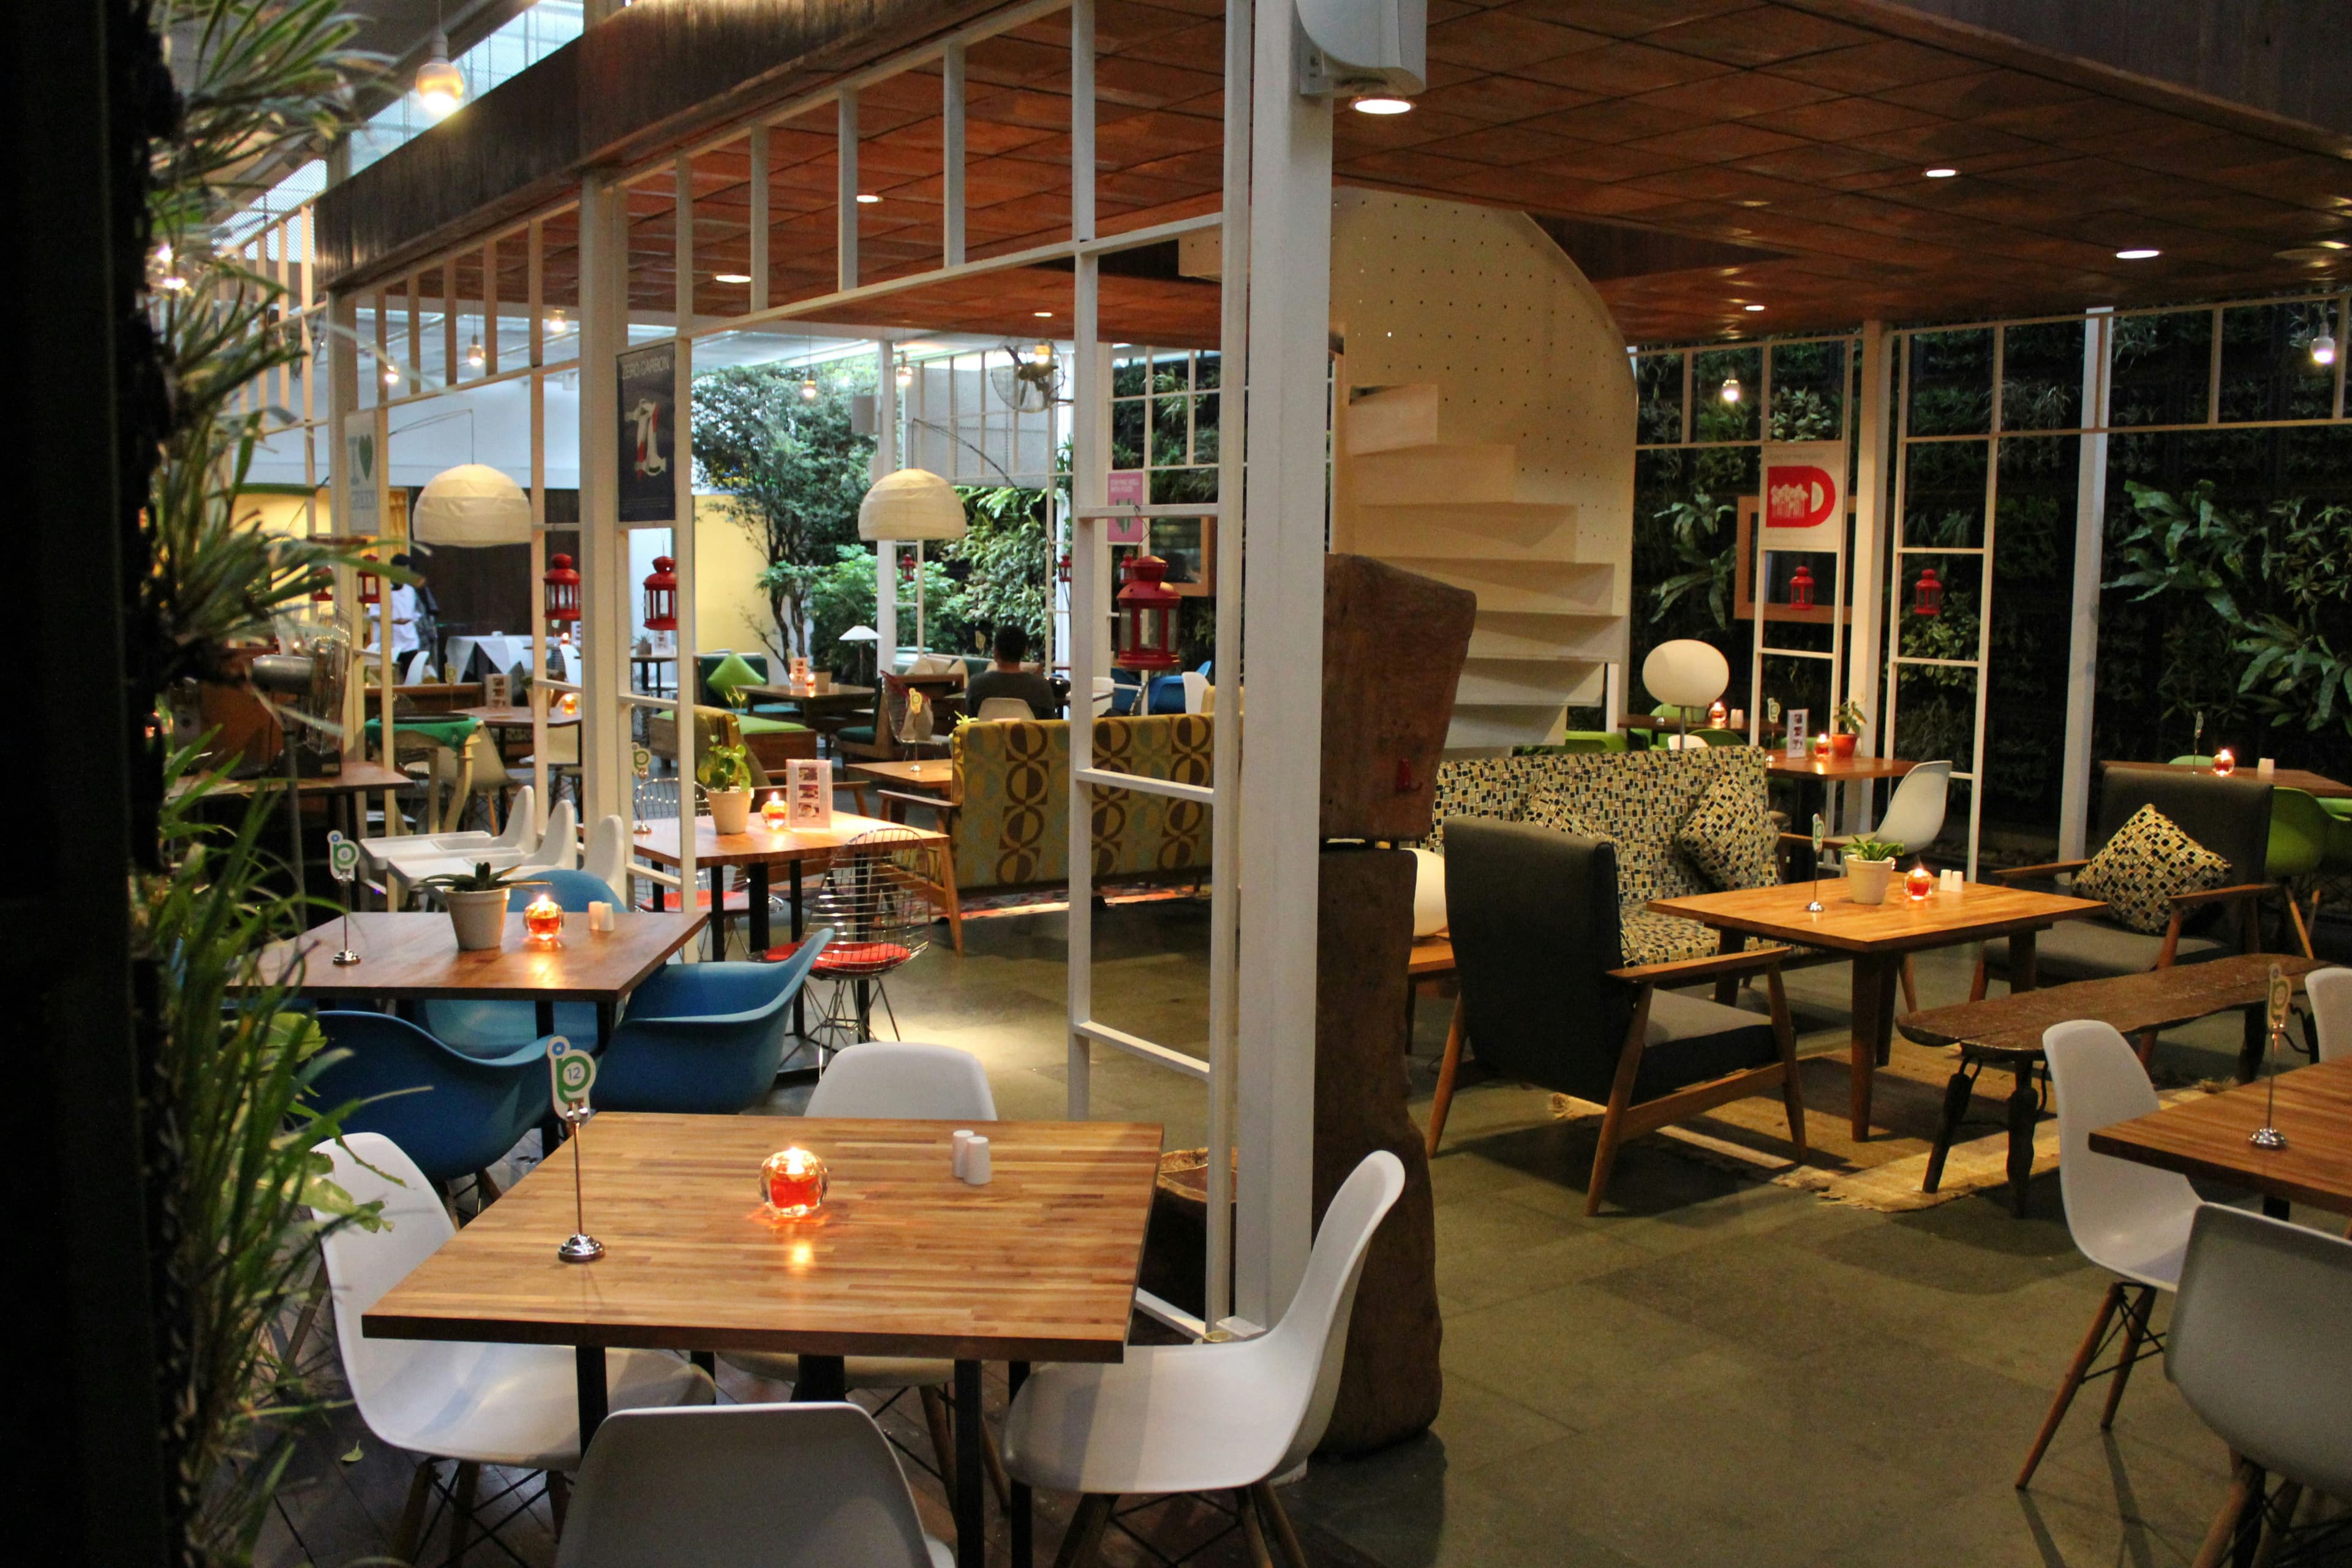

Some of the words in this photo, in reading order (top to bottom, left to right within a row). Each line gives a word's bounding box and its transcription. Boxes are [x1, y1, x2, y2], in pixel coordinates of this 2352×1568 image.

[622, 362, 639, 379] ZERO
[641, 356, 669, 376] CARBON
[567, 1067, 581, 1080] 12
